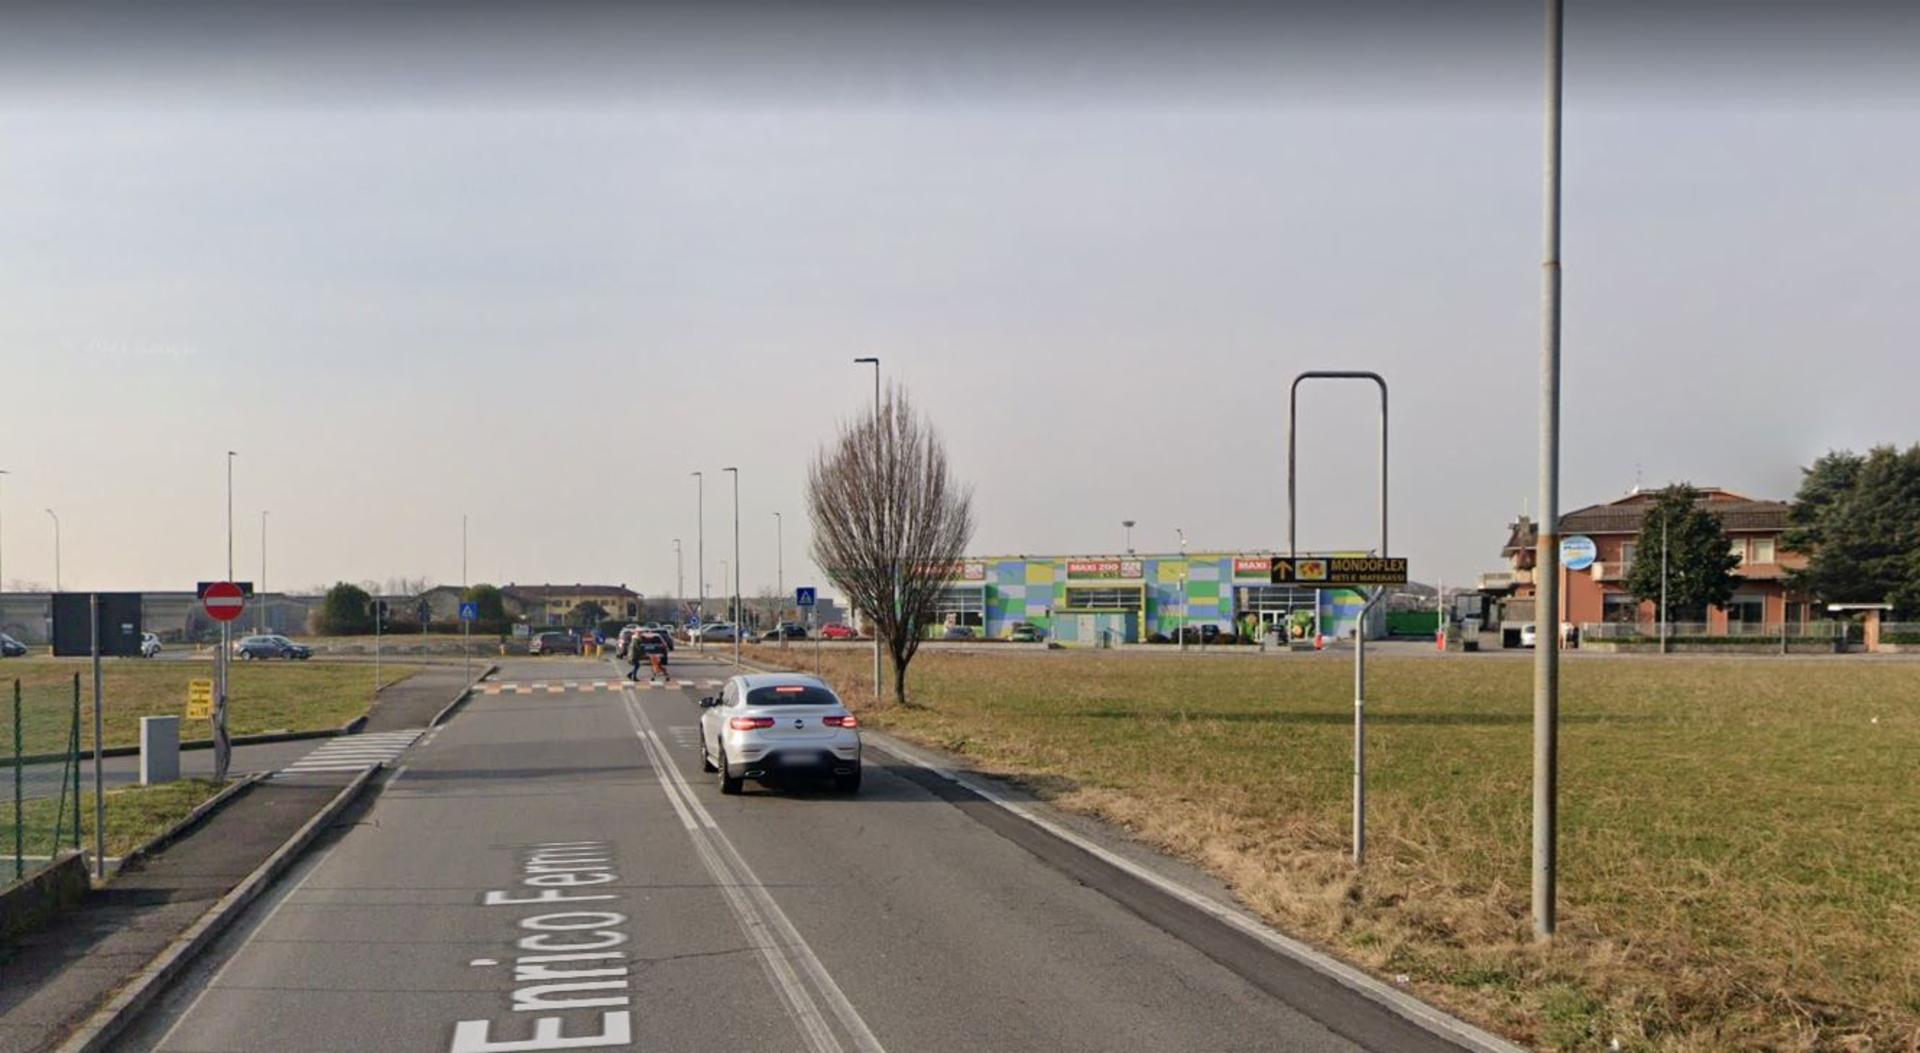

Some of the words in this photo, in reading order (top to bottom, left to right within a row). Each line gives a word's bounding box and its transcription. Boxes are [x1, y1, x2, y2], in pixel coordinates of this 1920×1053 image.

[1070, 563, 1096, 572] MAXI
[1098, 563, 1119, 571] ZOO
[1239, 561, 1266, 571] MAXI
[1331, 560, 1404, 571] MONDOFLEX
